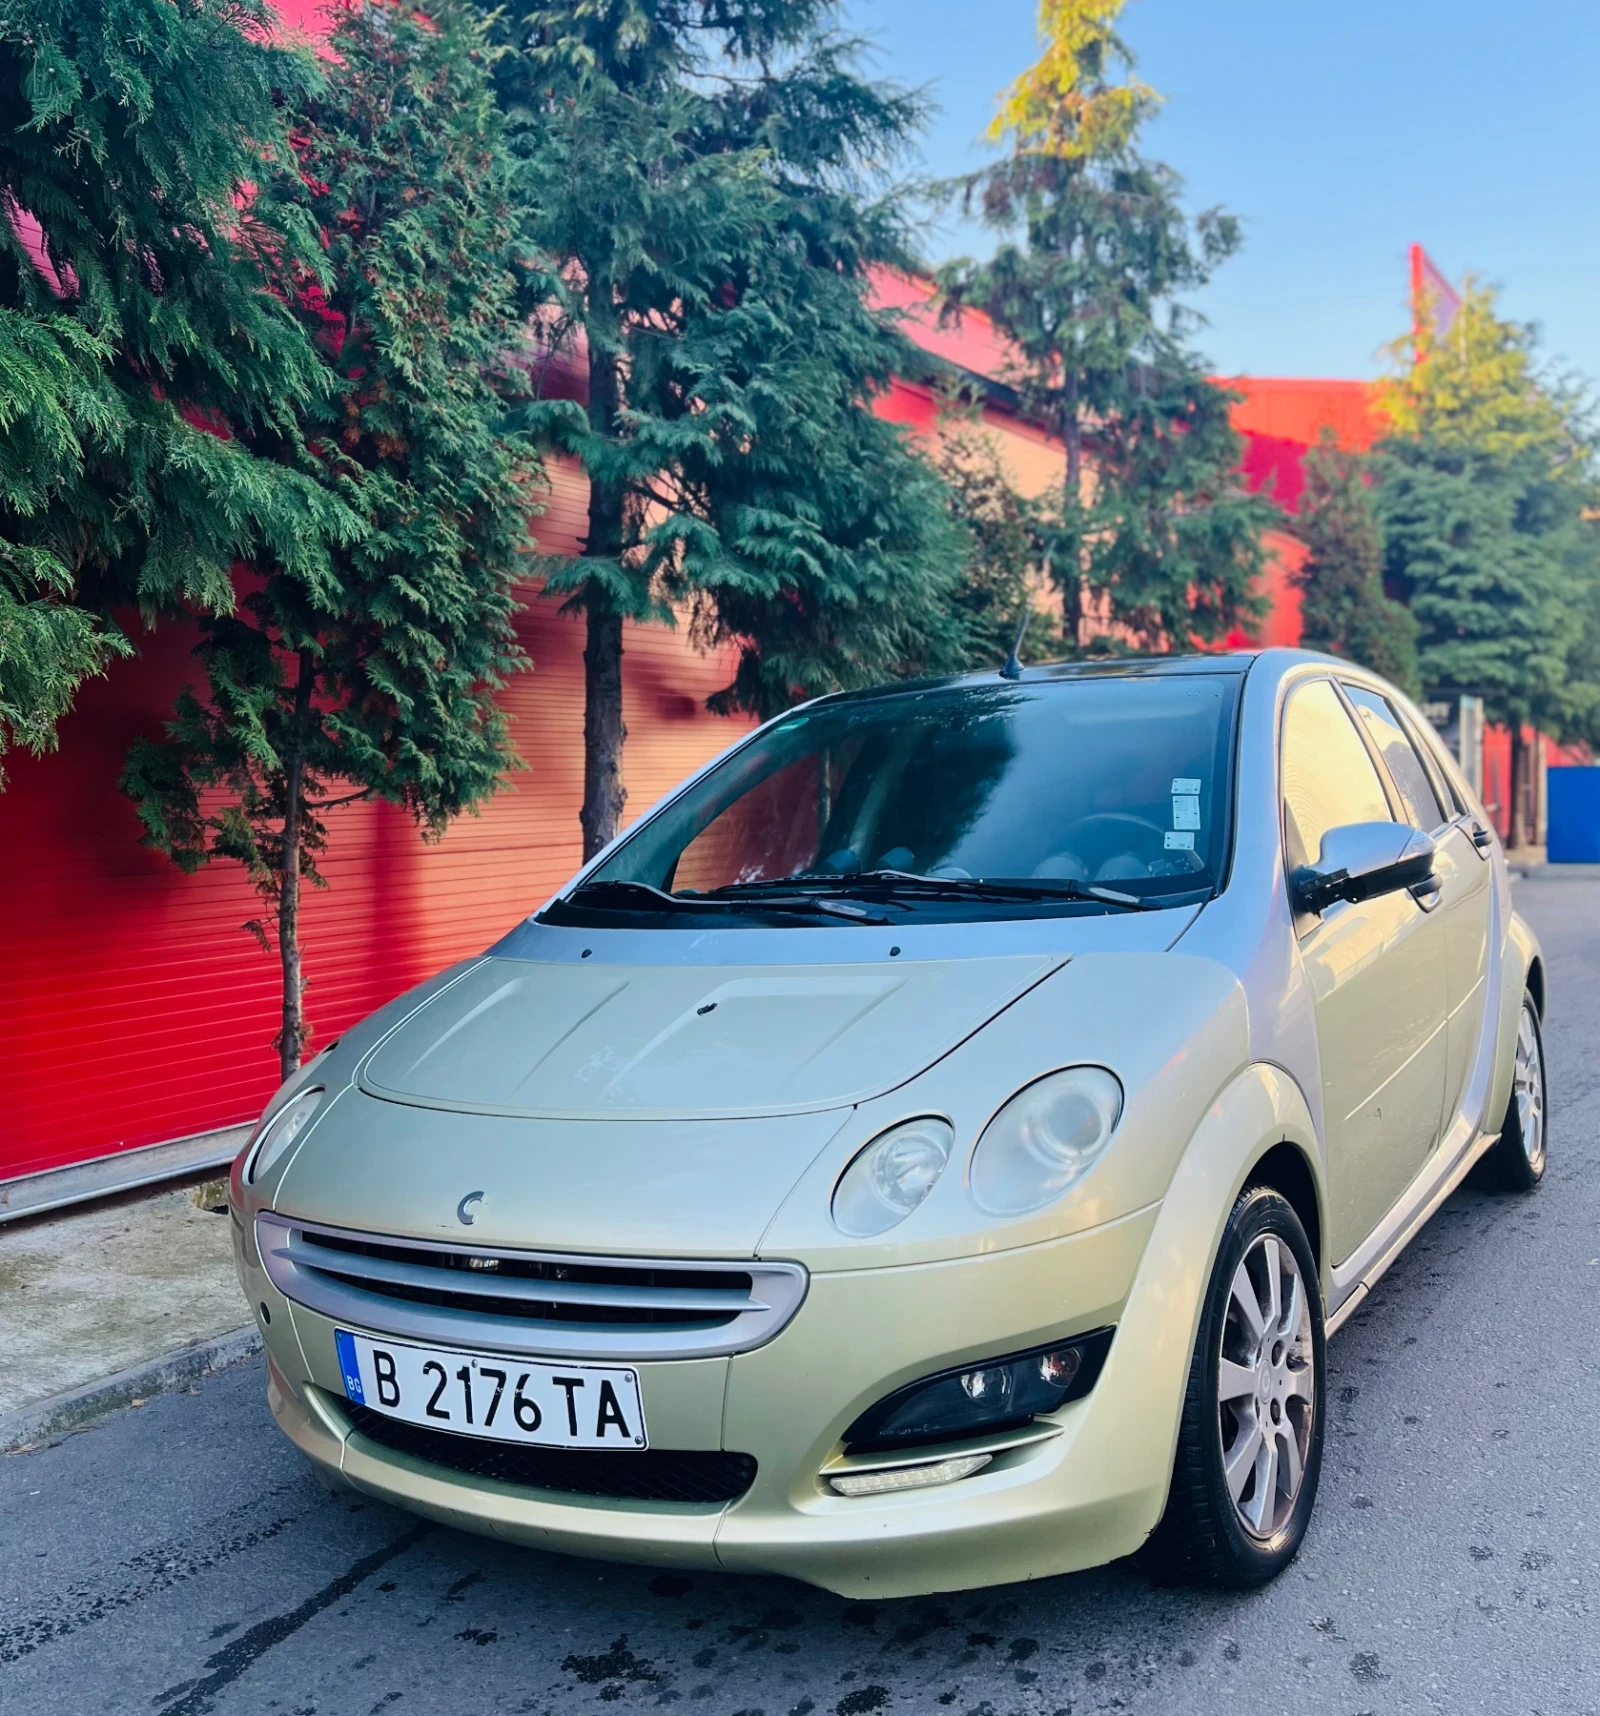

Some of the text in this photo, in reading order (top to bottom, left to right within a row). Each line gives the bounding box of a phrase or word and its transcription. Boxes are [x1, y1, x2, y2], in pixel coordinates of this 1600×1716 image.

[346, 1375, 362, 1394] BG
[373, 1349, 631, 1438] B 2176 TA
